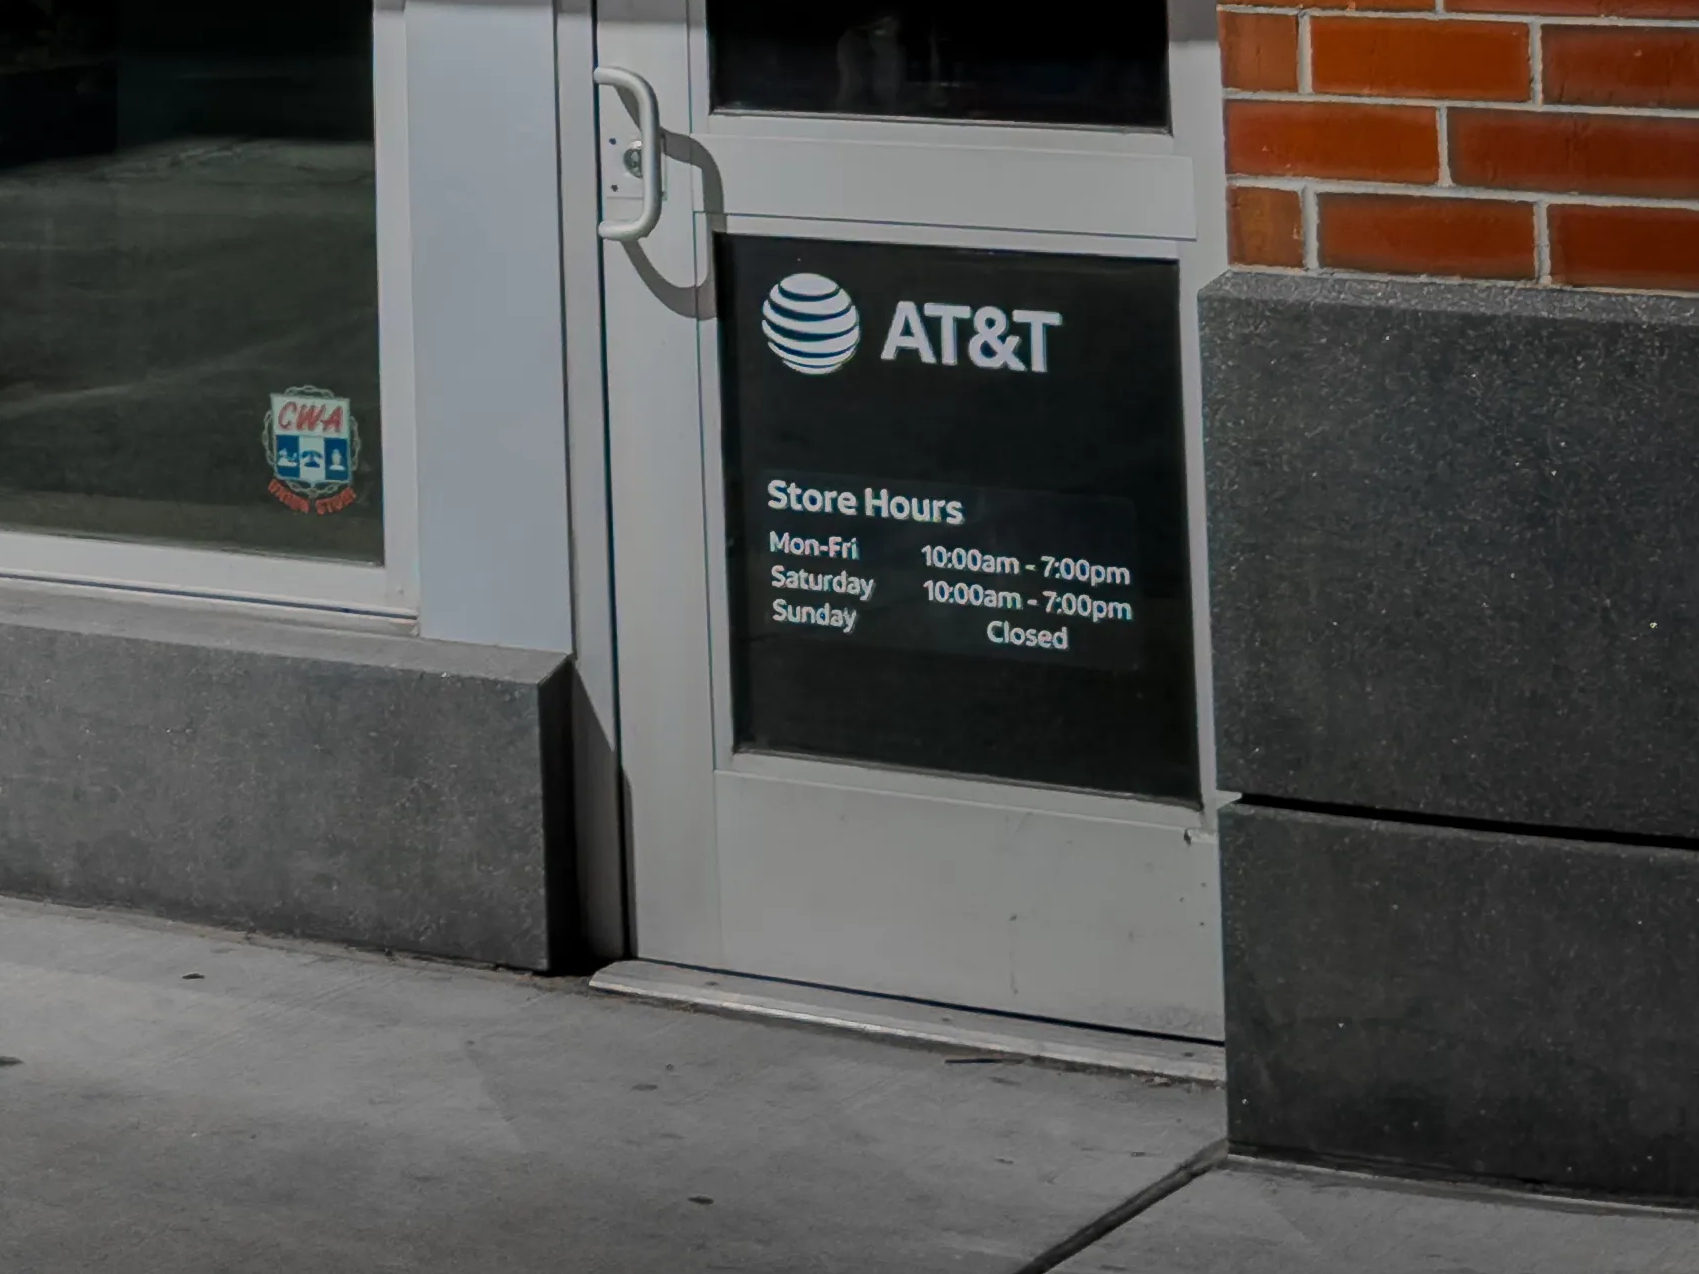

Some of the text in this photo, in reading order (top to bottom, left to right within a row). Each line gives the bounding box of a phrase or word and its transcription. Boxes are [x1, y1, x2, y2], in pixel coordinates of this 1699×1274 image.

[880, 300, 1064, 373] AT&T
[278, 400, 345, 433] CWA
[767, 479, 966, 525] Store Hours
[769, 530, 860, 560] Mon-Fri
[921, 544, 1021, 575] 10:00am
[1040, 555, 1132, 586] 7:00pm
[771, 564, 876, 601] Saturday
[923, 579, 1023, 609] 10:00am
[1042, 590, 1133, 622] 7:00pm
[772, 599, 1070, 651] Sunday Closed
